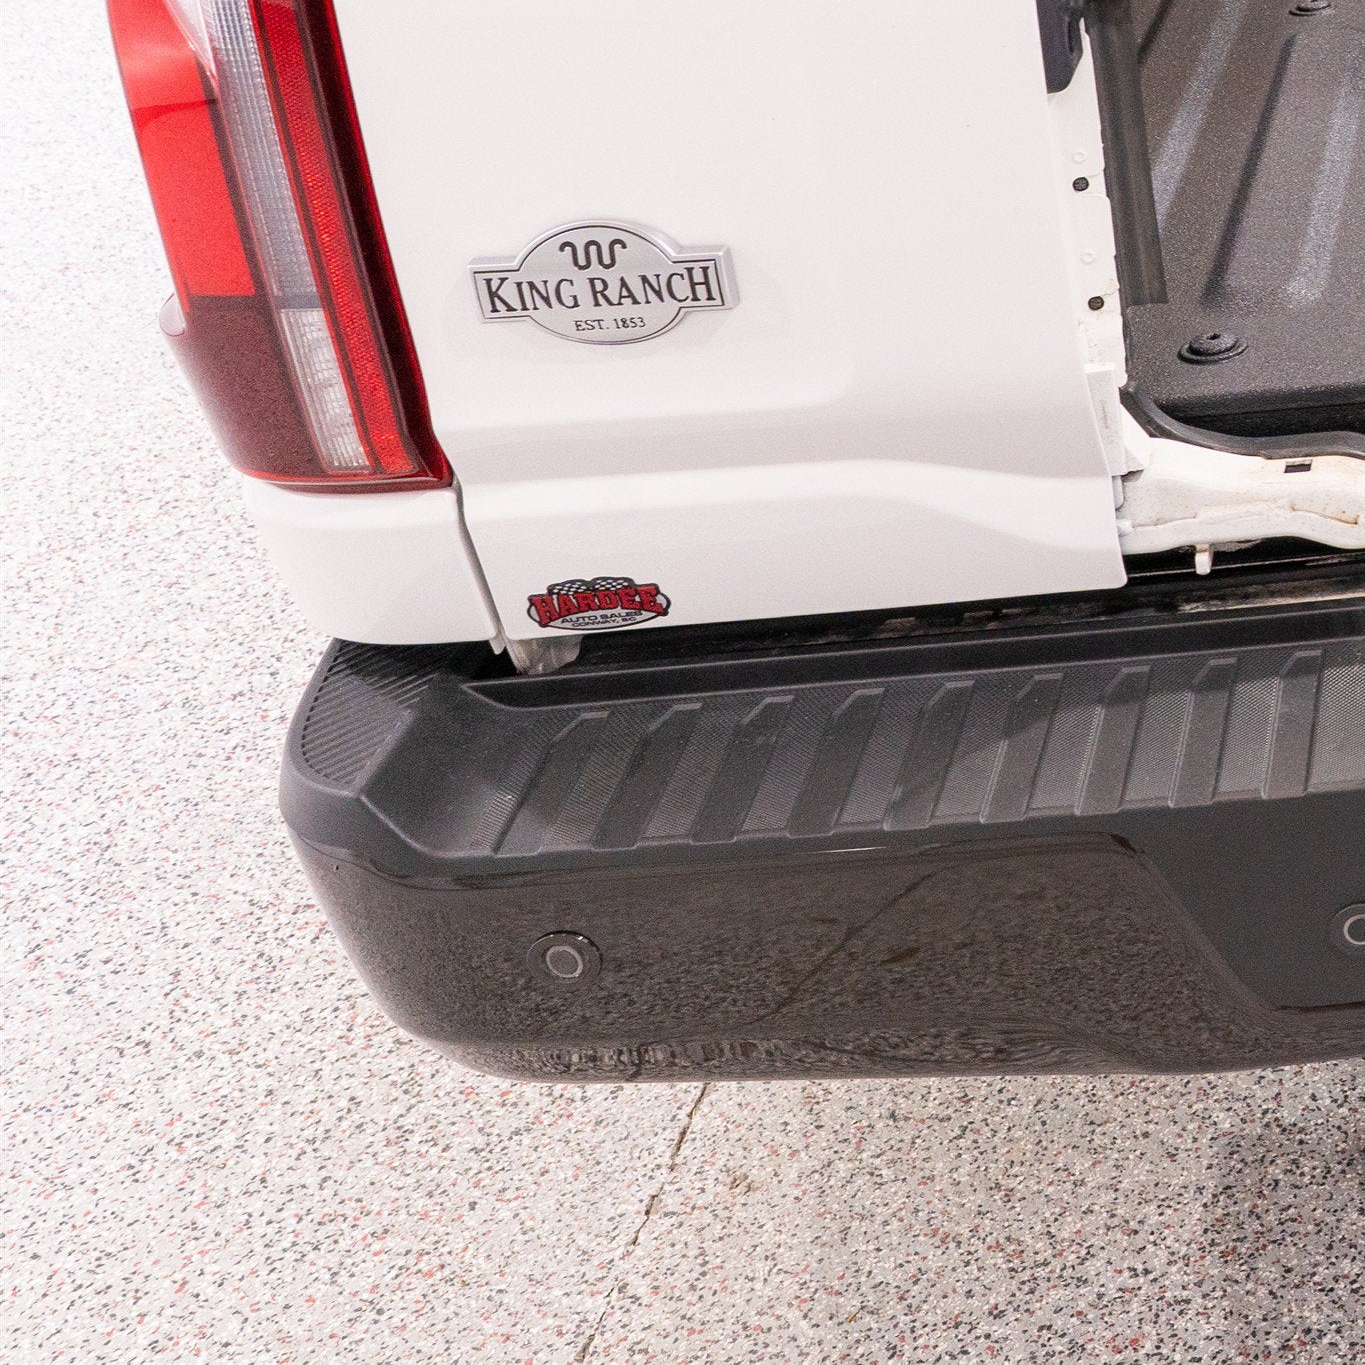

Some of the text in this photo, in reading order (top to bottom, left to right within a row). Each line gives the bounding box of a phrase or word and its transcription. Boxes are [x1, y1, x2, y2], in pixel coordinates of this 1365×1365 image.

[483, 266, 717, 313] KING RANCH
[574, 316, 646, 332] EST. 1853
[531, 585, 665, 625] HARDEE
[560, 610, 643, 624] AUTO SALES
